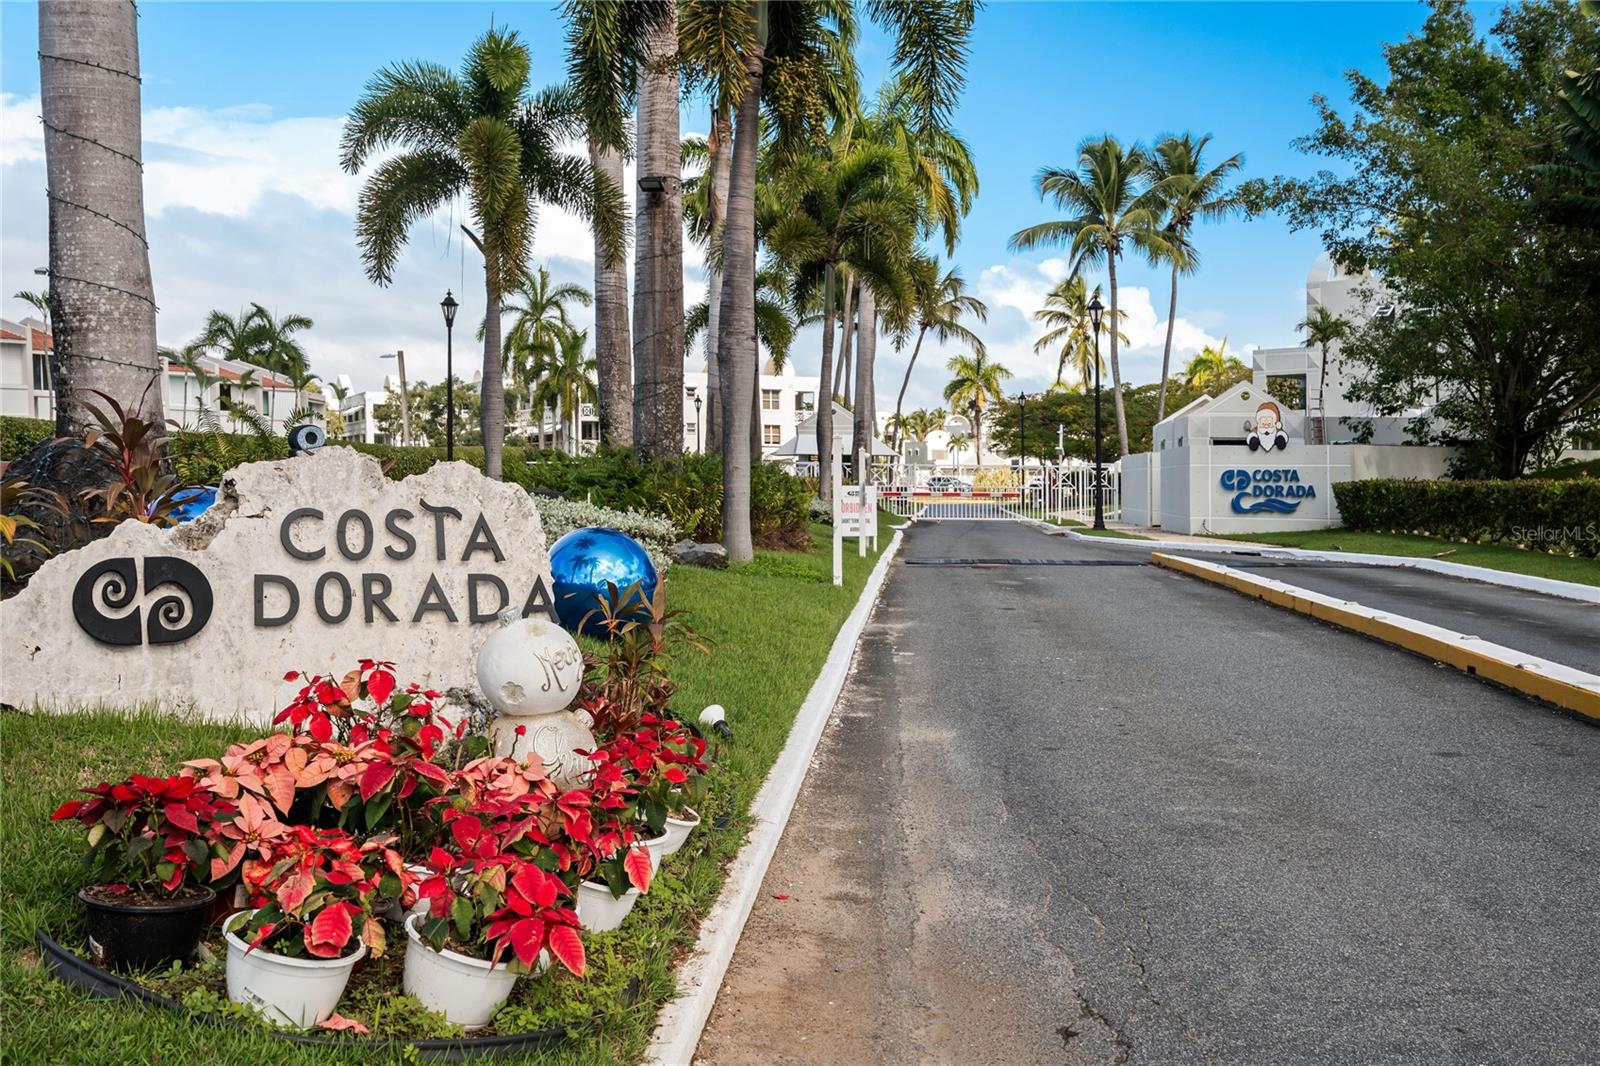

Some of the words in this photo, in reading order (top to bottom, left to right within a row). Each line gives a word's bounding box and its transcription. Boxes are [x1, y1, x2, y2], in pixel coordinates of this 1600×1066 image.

[1252, 469, 1300, 482] COSTA
[1252, 485, 1316, 498] DORADA
[280, 498, 506, 562] COSTA
[254, 571, 560, 627] DORADA
